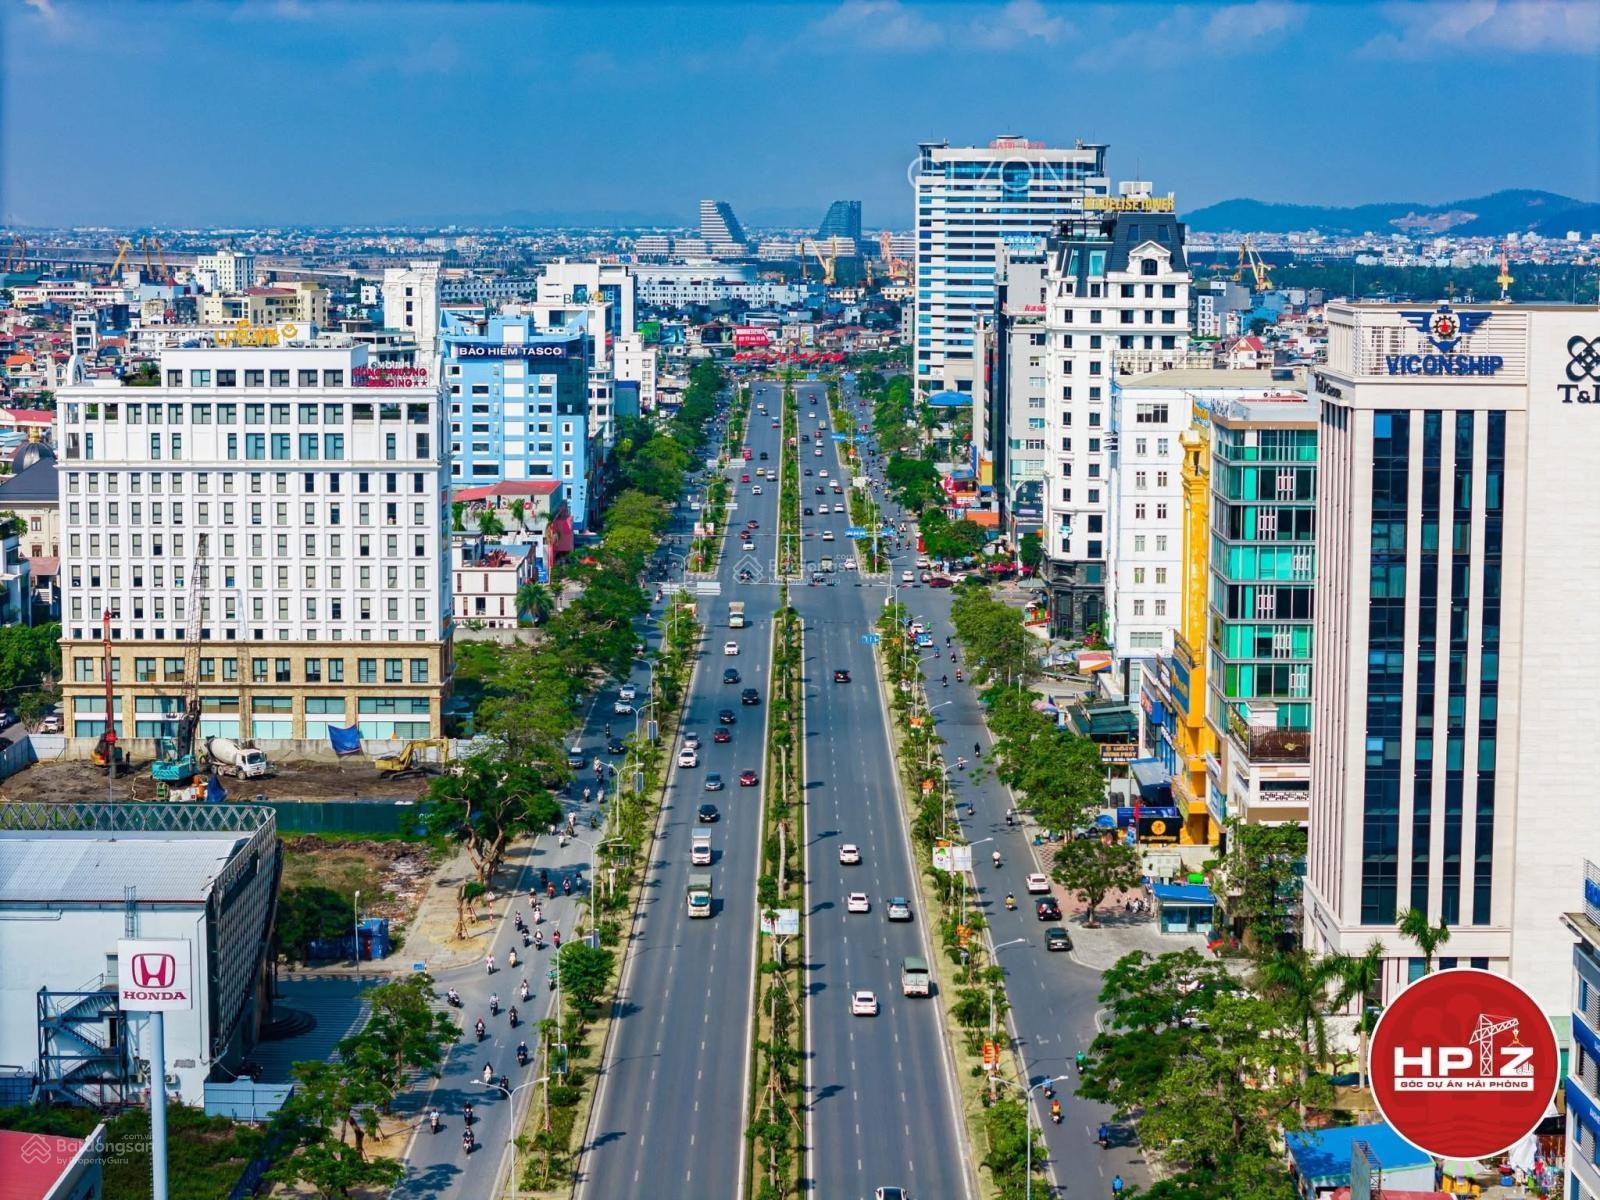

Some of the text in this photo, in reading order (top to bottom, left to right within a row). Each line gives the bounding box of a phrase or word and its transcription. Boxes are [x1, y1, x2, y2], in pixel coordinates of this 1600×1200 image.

[459, 344, 485, 356] BẢO
[521, 346, 562, 356] TASCO
[1386, 355, 1504, 376] VICONSHIP
[122, 991, 187, 1000] HONDA
